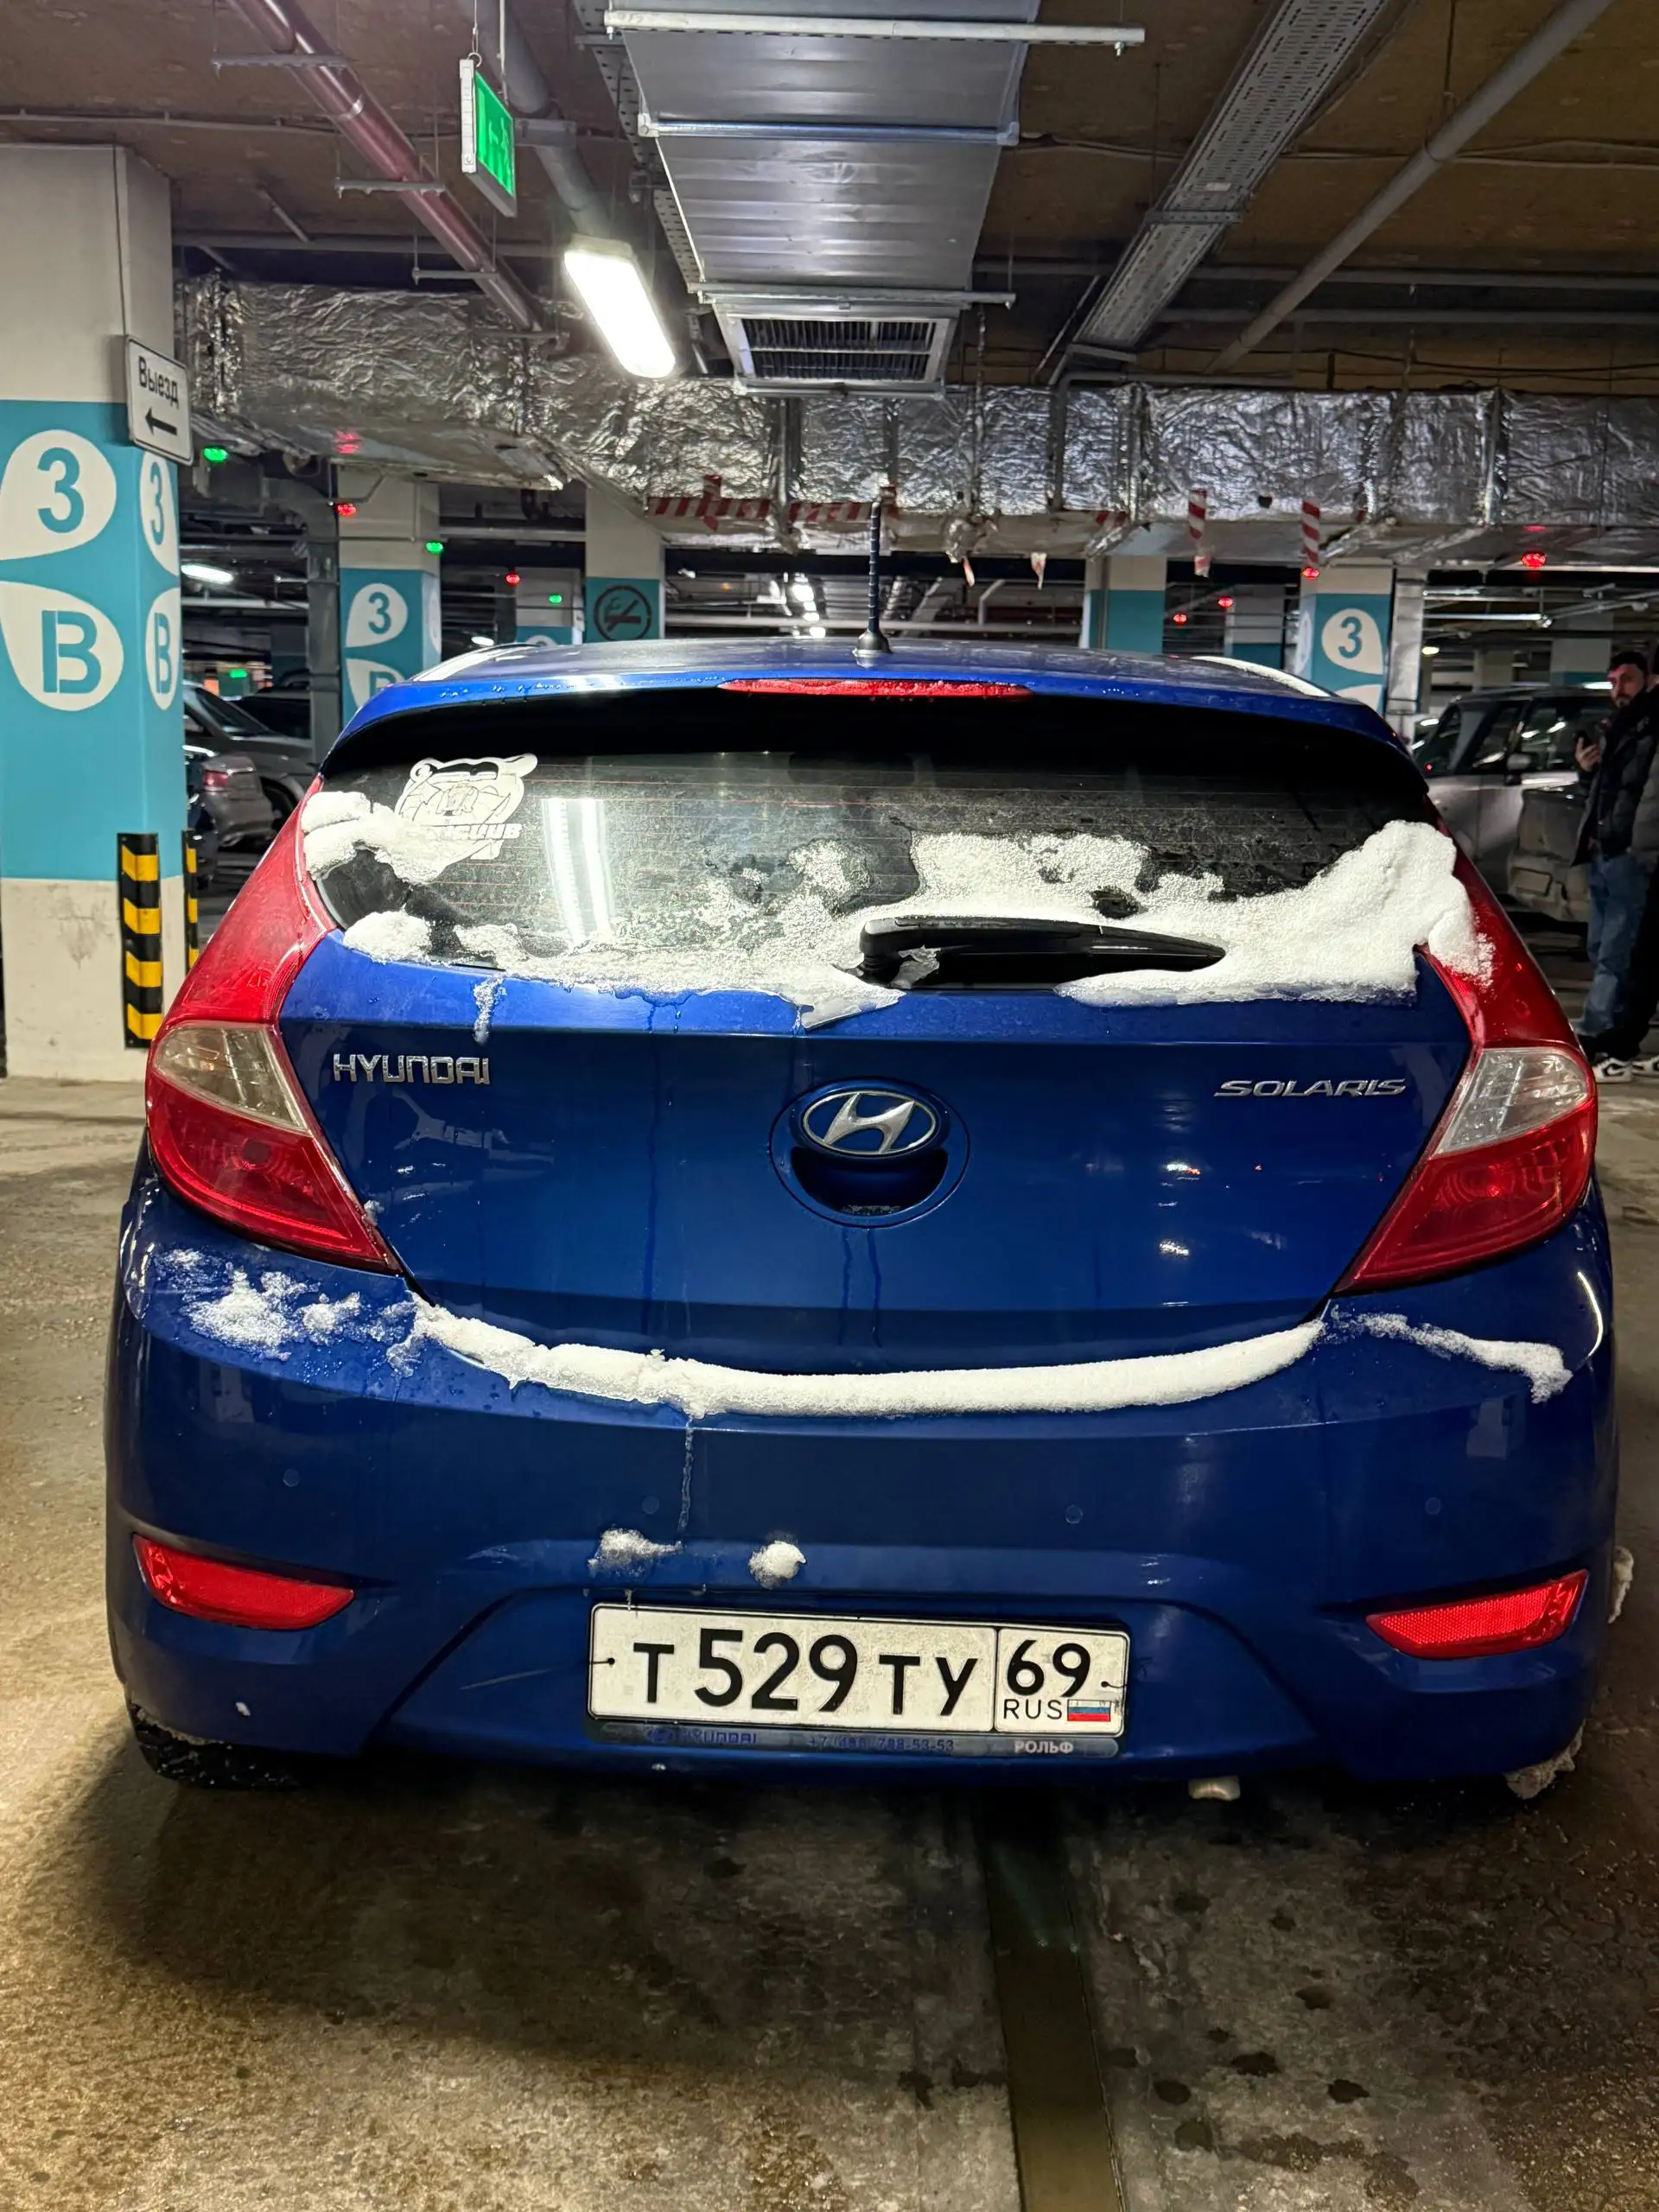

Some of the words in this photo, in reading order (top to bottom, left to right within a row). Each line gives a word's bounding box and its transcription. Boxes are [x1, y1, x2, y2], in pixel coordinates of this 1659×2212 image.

[138, 355, 180, 410] Выезд
[37, 447, 85, 534] 3
[149, 461, 165, 546] 3
[368, 592, 391, 634] 3
[1338, 616, 1363, 658] 3
[333, 1053, 491, 1085] HYUNDAI
[1213, 1077, 1407, 1097] SOLARIS
[1006, 1639, 1092, 1698] 69
[1003, 1698, 1063, 1719] RUS
[1014, 1739, 1074, 1754] РОЛЬФ
